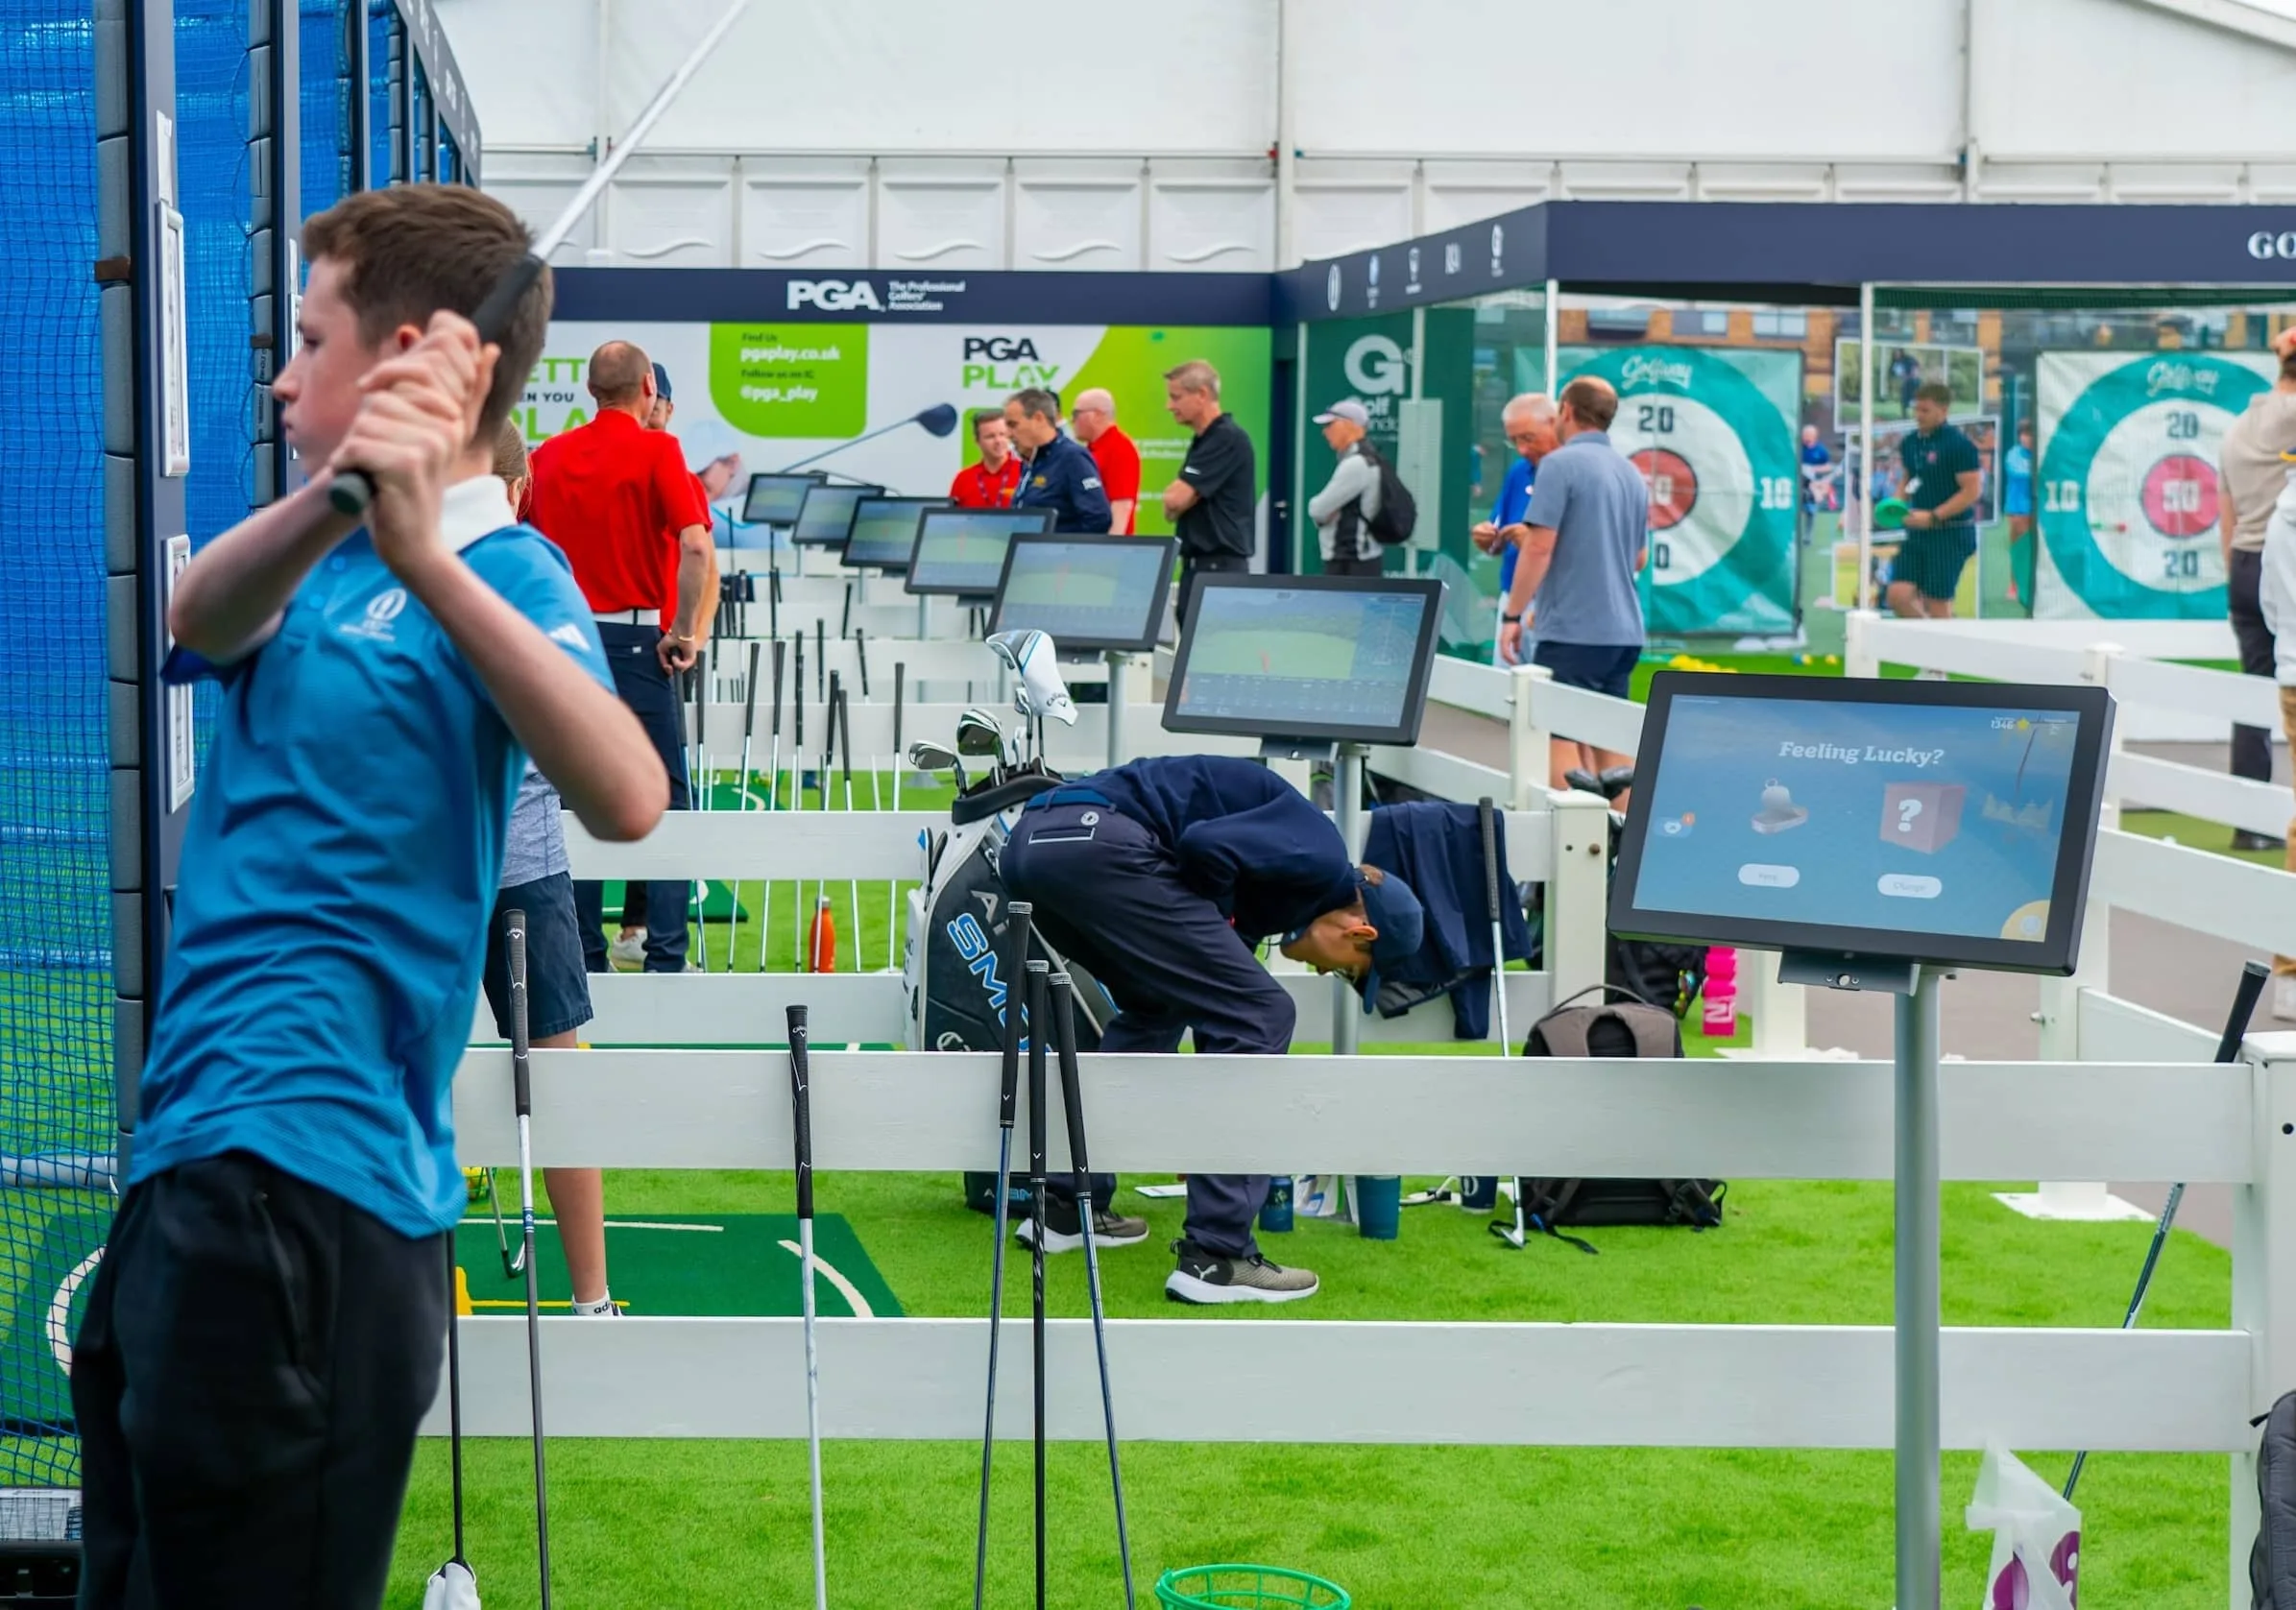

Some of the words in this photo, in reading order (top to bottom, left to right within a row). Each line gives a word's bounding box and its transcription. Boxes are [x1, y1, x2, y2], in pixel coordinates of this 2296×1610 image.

[786, 279, 881, 310] PGA
[907, 280, 965, 292] Professional
[740, 345, 840, 363] pgaplay.co.uk
[964, 337, 1039, 361] PGA
[962, 364, 1060, 389] PLAY
[543, 392, 574, 402] YOU
[740, 384, 817, 402] @pga_play
[1638, 405, 1674, 432] 20
[2166, 412, 2199, 439] 20
[1760, 477, 1793, 509] 10
[2045, 480, 2079, 512] 10
[2163, 550, 2199, 578] 20
[1778, 741, 1861, 764] Feeling
[1863, 745, 1945, 768] Lucky?
[1897, 799, 1922, 832] ?
